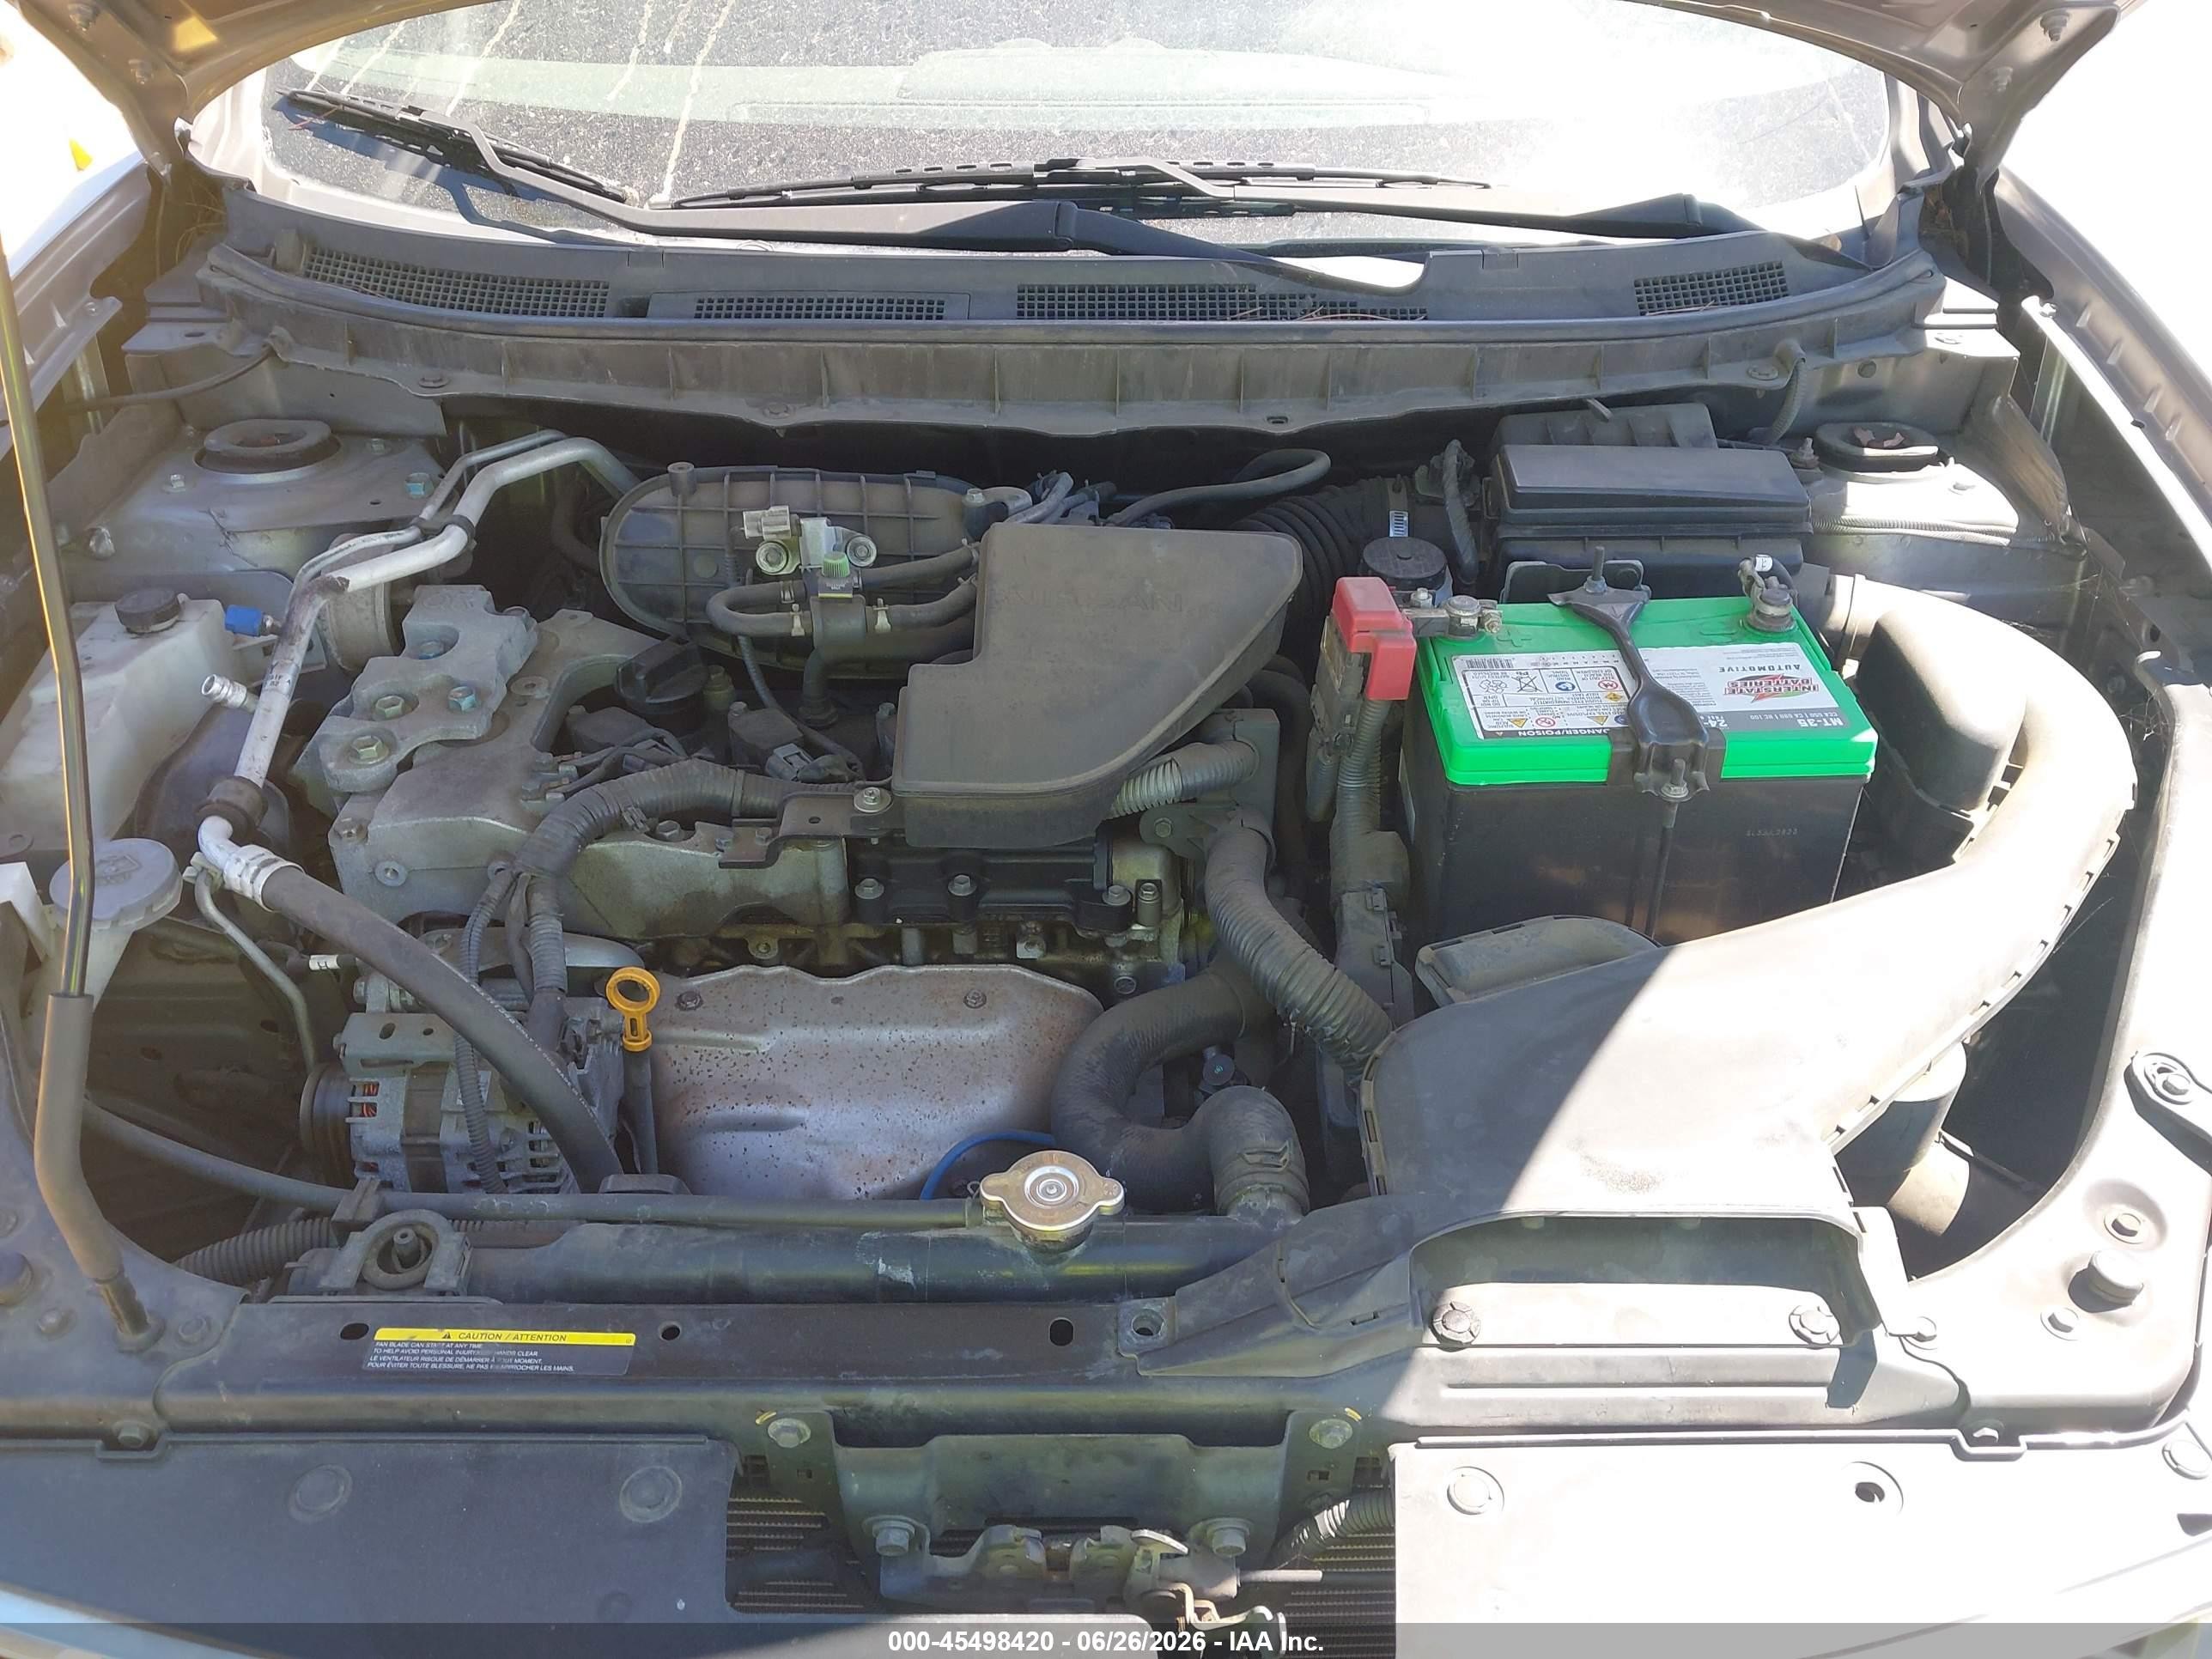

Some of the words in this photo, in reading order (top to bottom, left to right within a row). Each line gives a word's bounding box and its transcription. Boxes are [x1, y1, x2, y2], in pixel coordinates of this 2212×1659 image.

[1718, 664, 1801, 672] AUTOMOTIVE
[1730, 679, 1809, 688] BATTERIES
[1727, 686, 1817, 695] INTERSTATE
[1796, 717, 1844, 727] MT-35
[459, 1332, 502, 1340] CAUTION
[513, 1334, 567, 1342] ATTENTION
